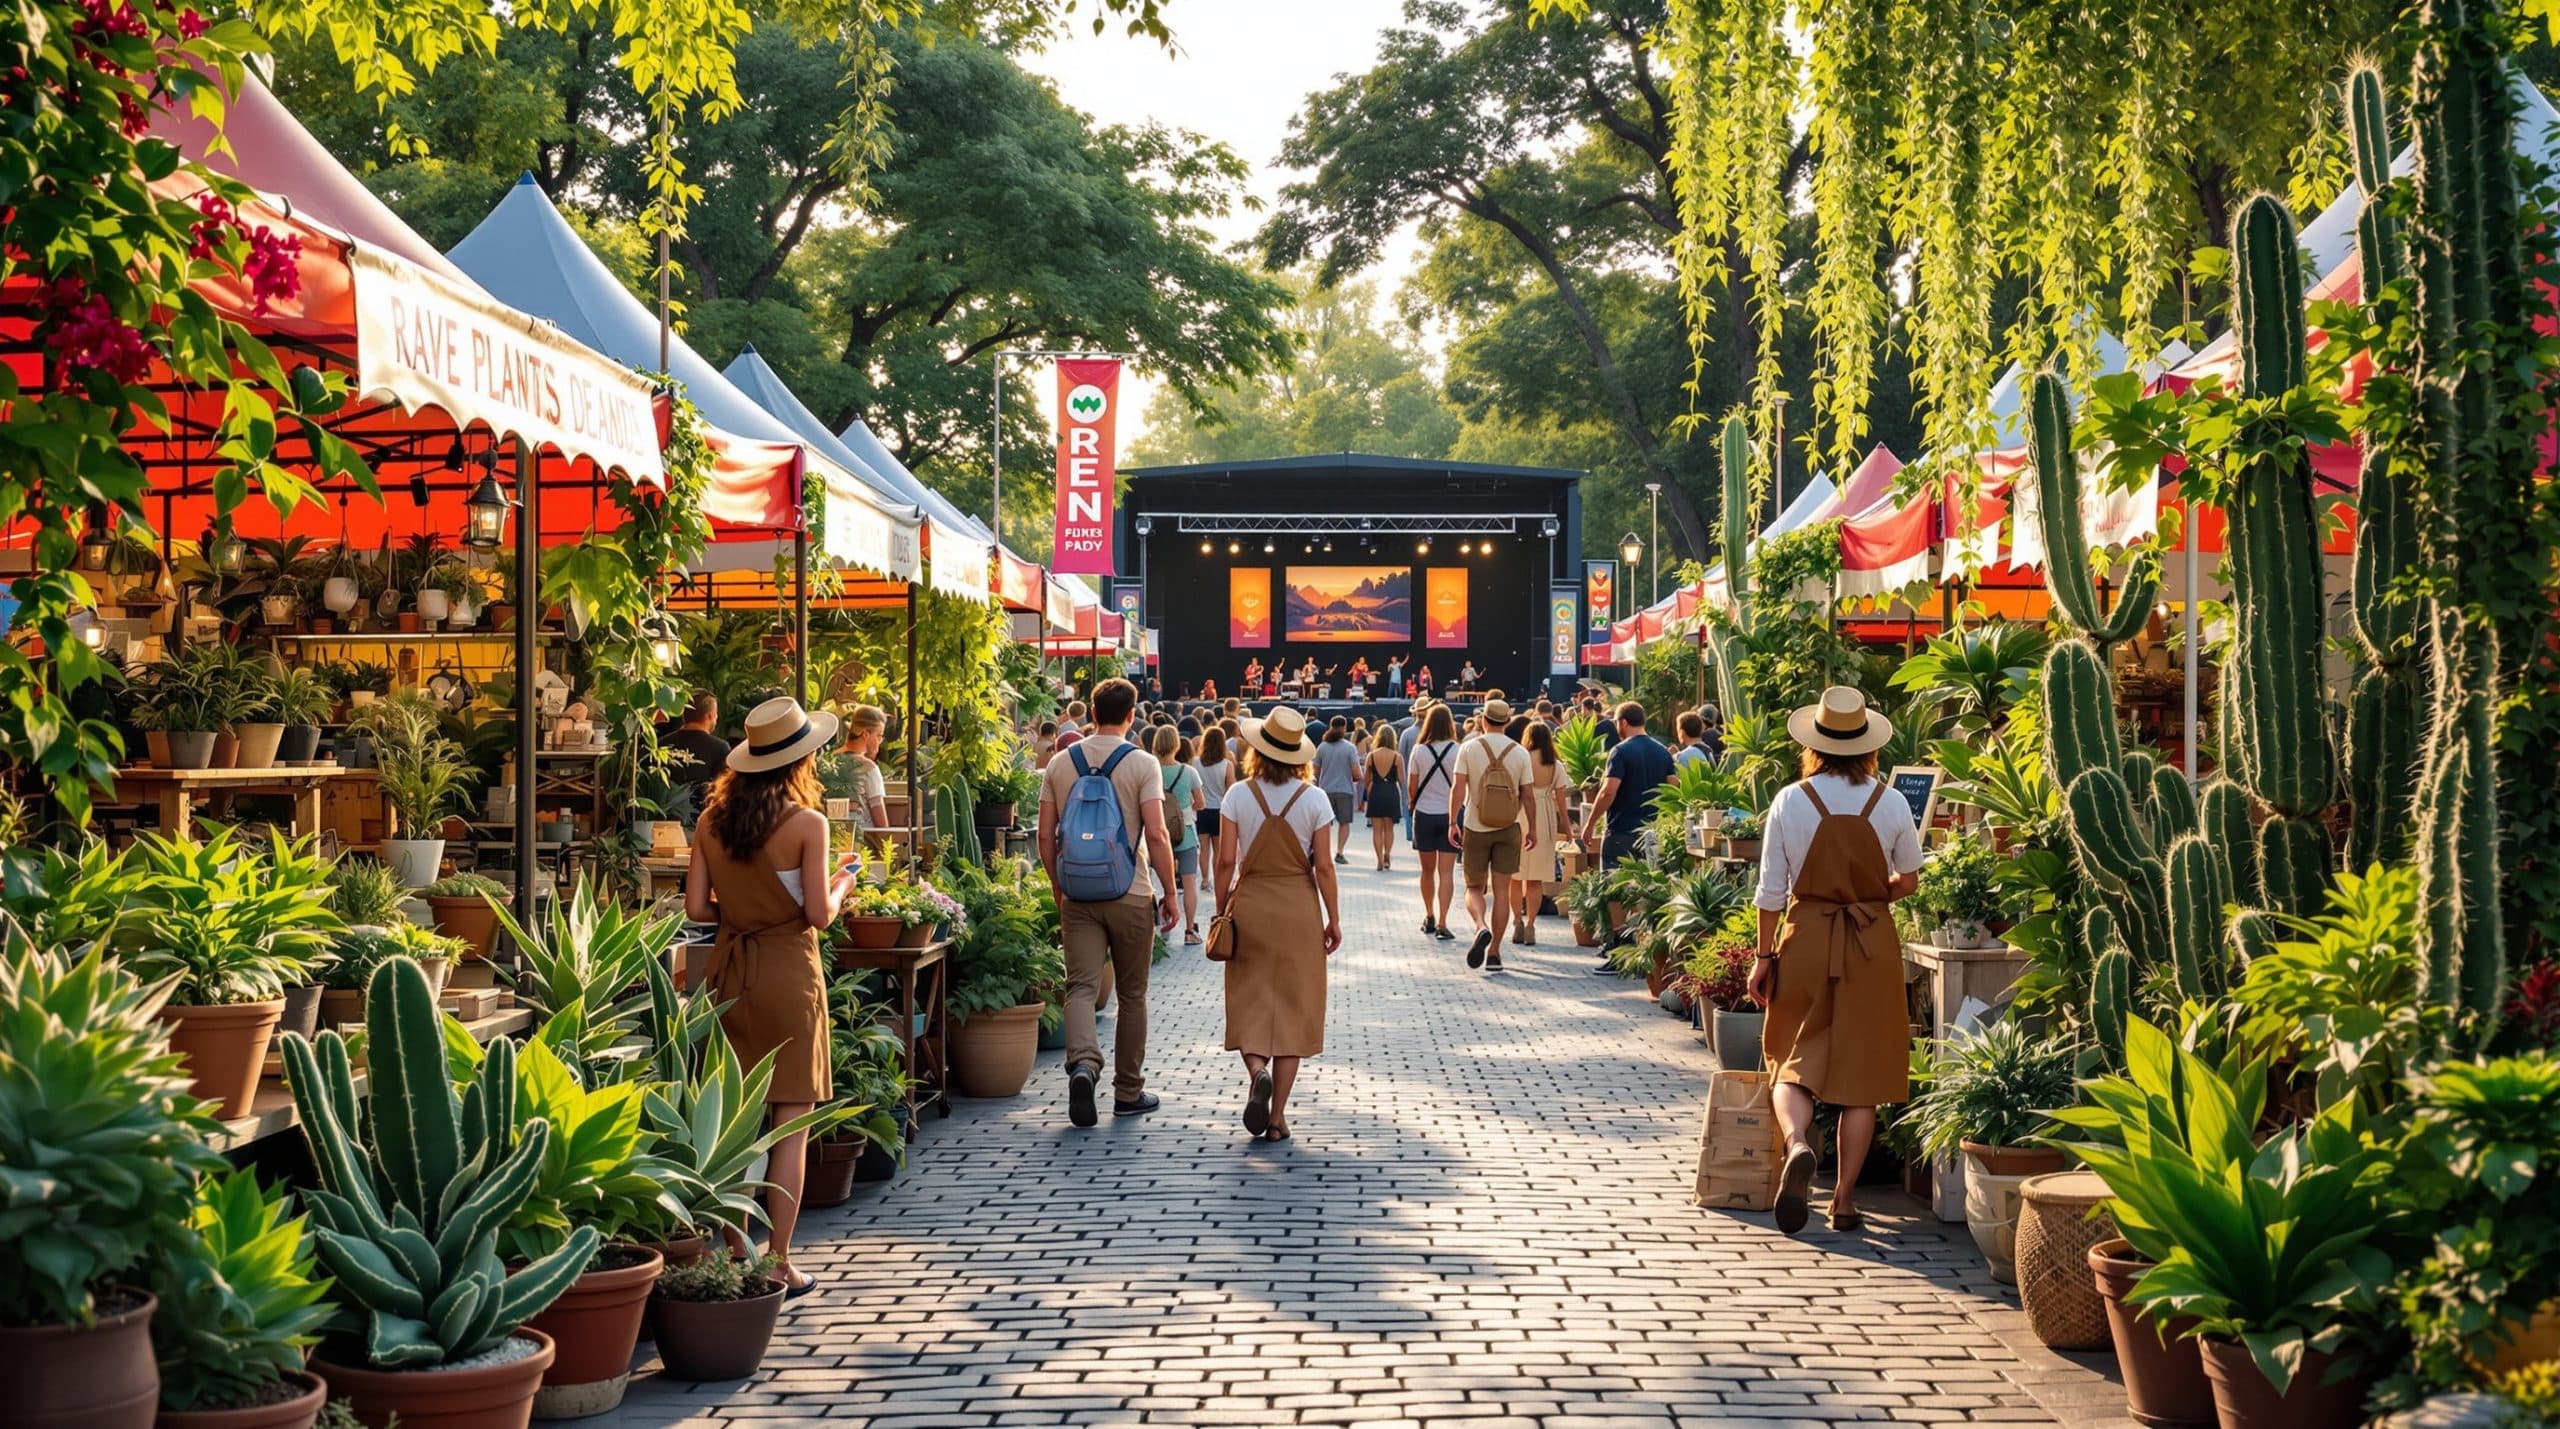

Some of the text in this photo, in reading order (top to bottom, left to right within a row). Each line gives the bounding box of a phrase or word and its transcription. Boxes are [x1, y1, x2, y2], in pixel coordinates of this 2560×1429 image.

[391, 295, 461, 386] RAVE
[471, 327, 561, 425] PLANTS
[1064, 540, 1104, 551] PADY
